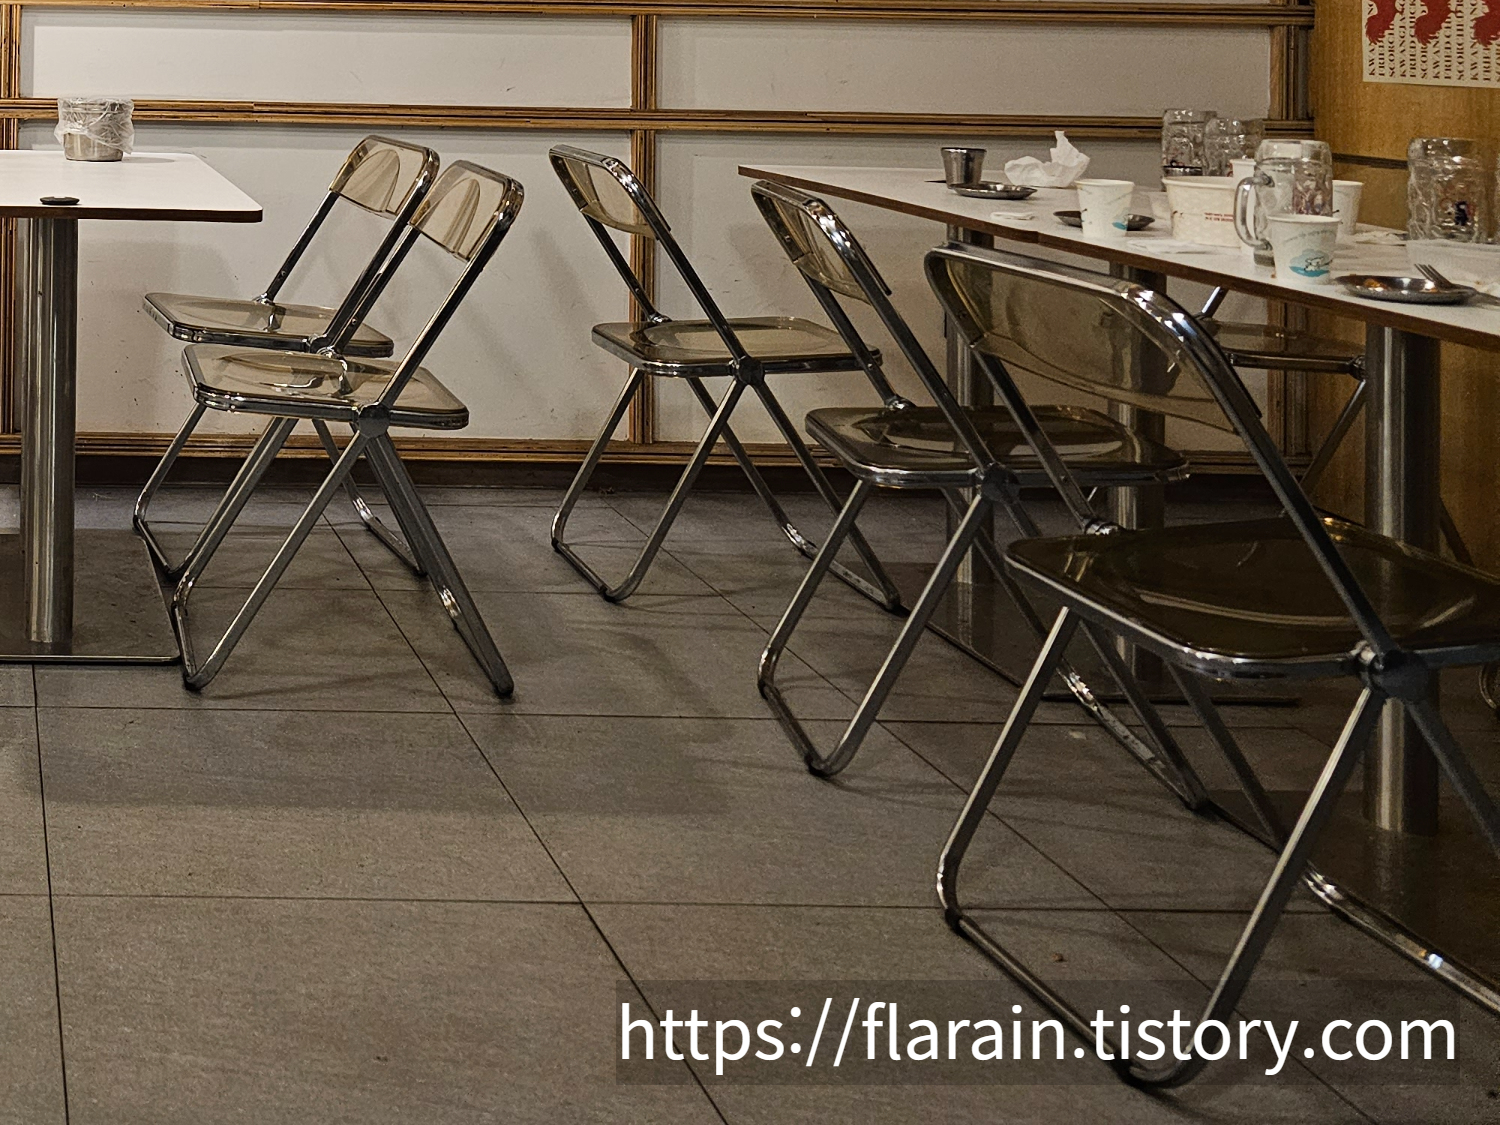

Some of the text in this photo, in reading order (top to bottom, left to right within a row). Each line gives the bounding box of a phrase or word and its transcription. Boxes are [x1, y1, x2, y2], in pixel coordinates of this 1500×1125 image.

[1408, 40, 1417, 78] FRIED
[1443, 41, 1452, 80] FRIED
[1455, 10, 1465, 81] SCORCHED
